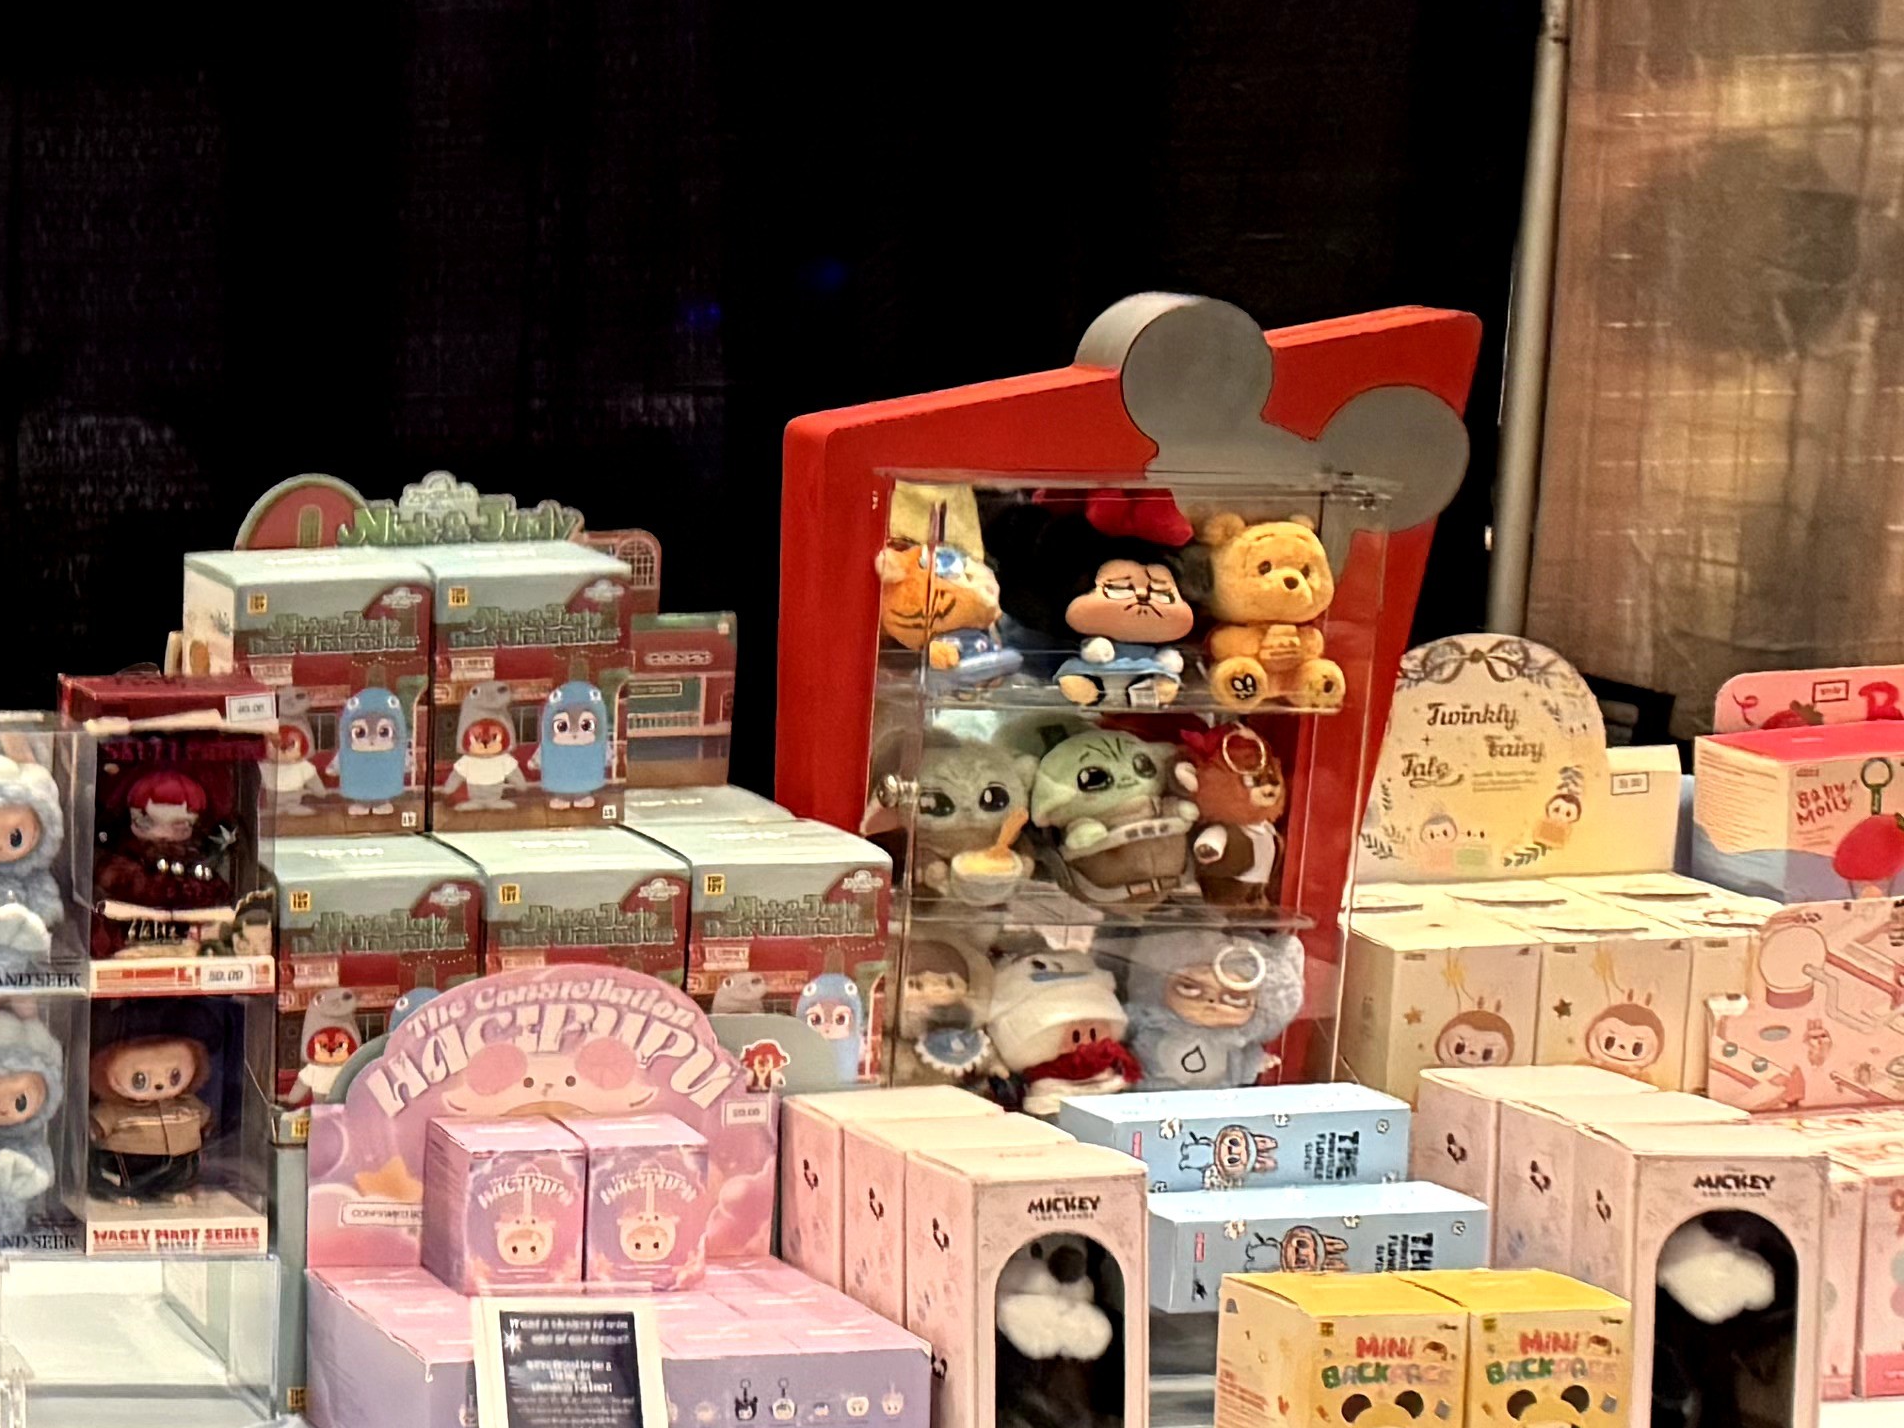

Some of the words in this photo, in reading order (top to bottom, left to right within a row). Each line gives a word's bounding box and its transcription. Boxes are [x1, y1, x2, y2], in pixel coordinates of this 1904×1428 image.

[1427, 701, 1517, 731] Twinkly
[407, 999, 466, 1040] The
[474, 977, 697, 1029] Constellation
[365, 1002, 738, 1119] HACIPUPU
[1693, 1174, 1776, 1192] MICKEY
[1026, 1195, 1101, 1214] MICKEY
[203, 1226, 260, 1241] SERIES
[1519, 1329, 1580, 1356] MINI
